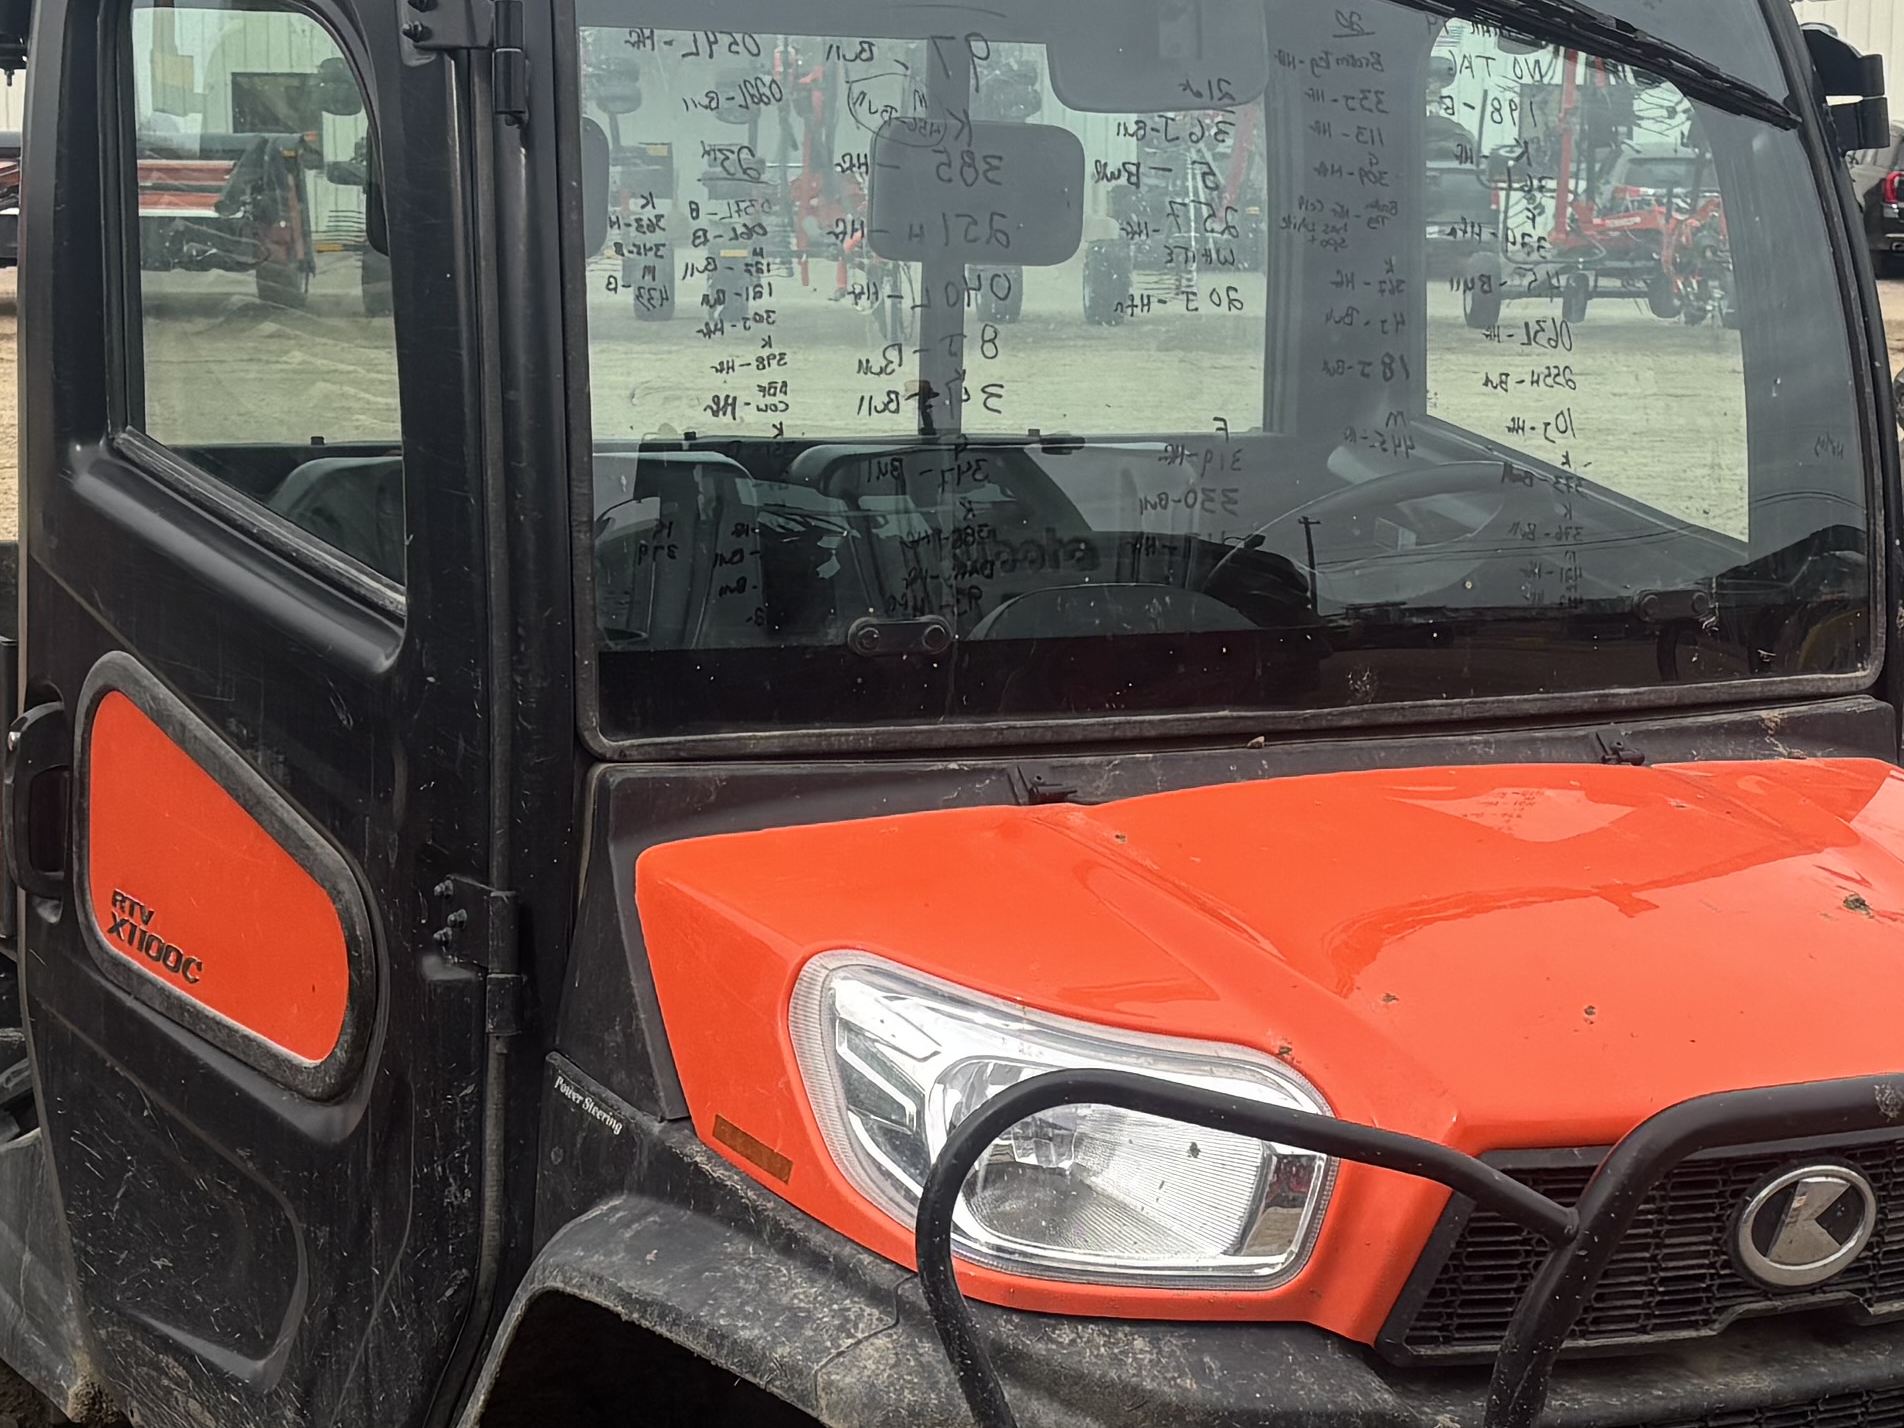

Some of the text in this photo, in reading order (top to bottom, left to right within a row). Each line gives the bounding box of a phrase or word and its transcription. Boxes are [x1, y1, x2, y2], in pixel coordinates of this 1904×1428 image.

[111, 888, 155, 926] RTV
[107, 910, 203, 985] X1100C
[554, 1075, 623, 1136] Power Steering
